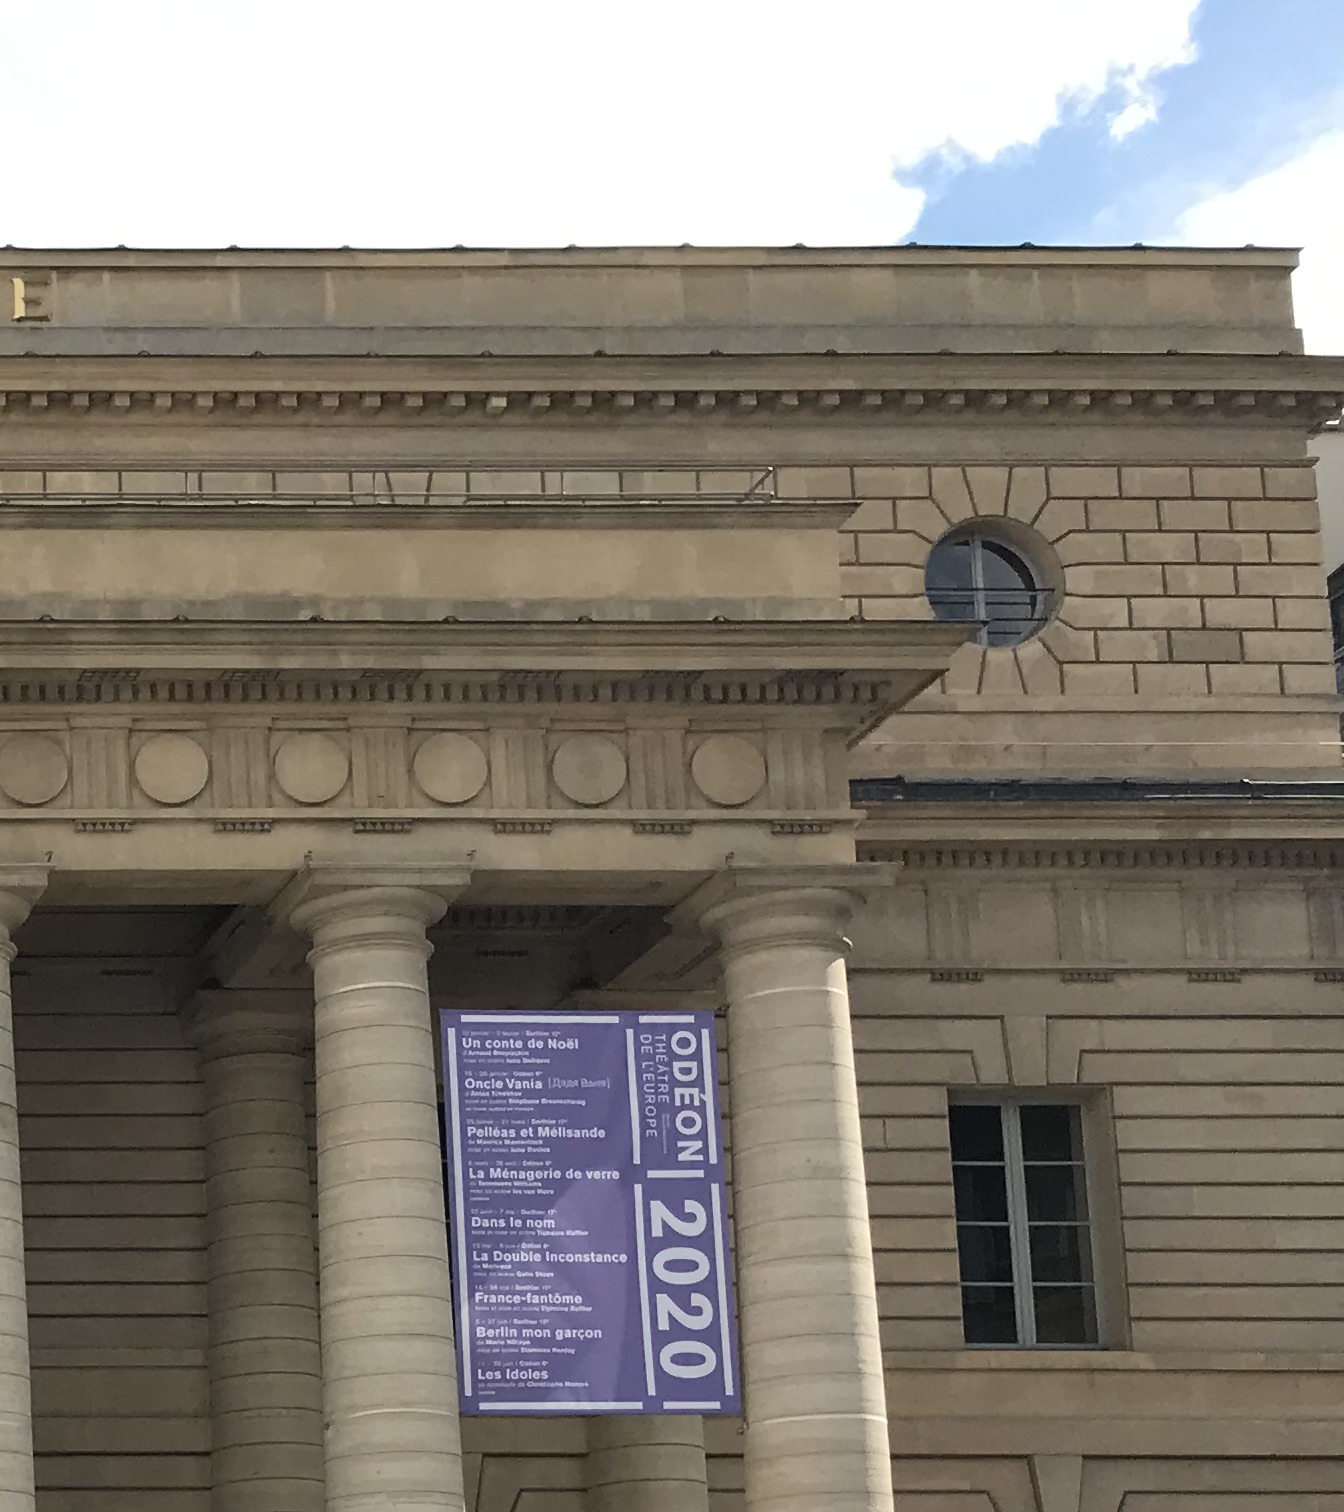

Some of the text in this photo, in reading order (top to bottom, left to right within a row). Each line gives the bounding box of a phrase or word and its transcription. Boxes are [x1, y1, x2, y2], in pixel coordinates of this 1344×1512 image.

[462, 1038, 579, 1050] Un conte de Noël
[464, 1078, 504, 1089] Oncle
[506, 1078, 543, 1089] Vania
[640, 1034, 657, 1138] DE L'EUROPE
[671, 1030, 707, 1162] ODÉON
[467, 1126, 606, 1138] Pelléas et Mélisande
[469, 1168, 620, 1181] La Ménagerie de verre
[471, 1217, 556, 1228] Dans le nom
[472, 1251, 628, 1263] La Double Inconstance
[649, 1199, 717, 1379] 2020
[475, 1292, 583, 1304] France-fantôme
[476, 1327, 602, 1340] Berlin mon garçon
[477, 1368, 548, 1380] Les Idoles
